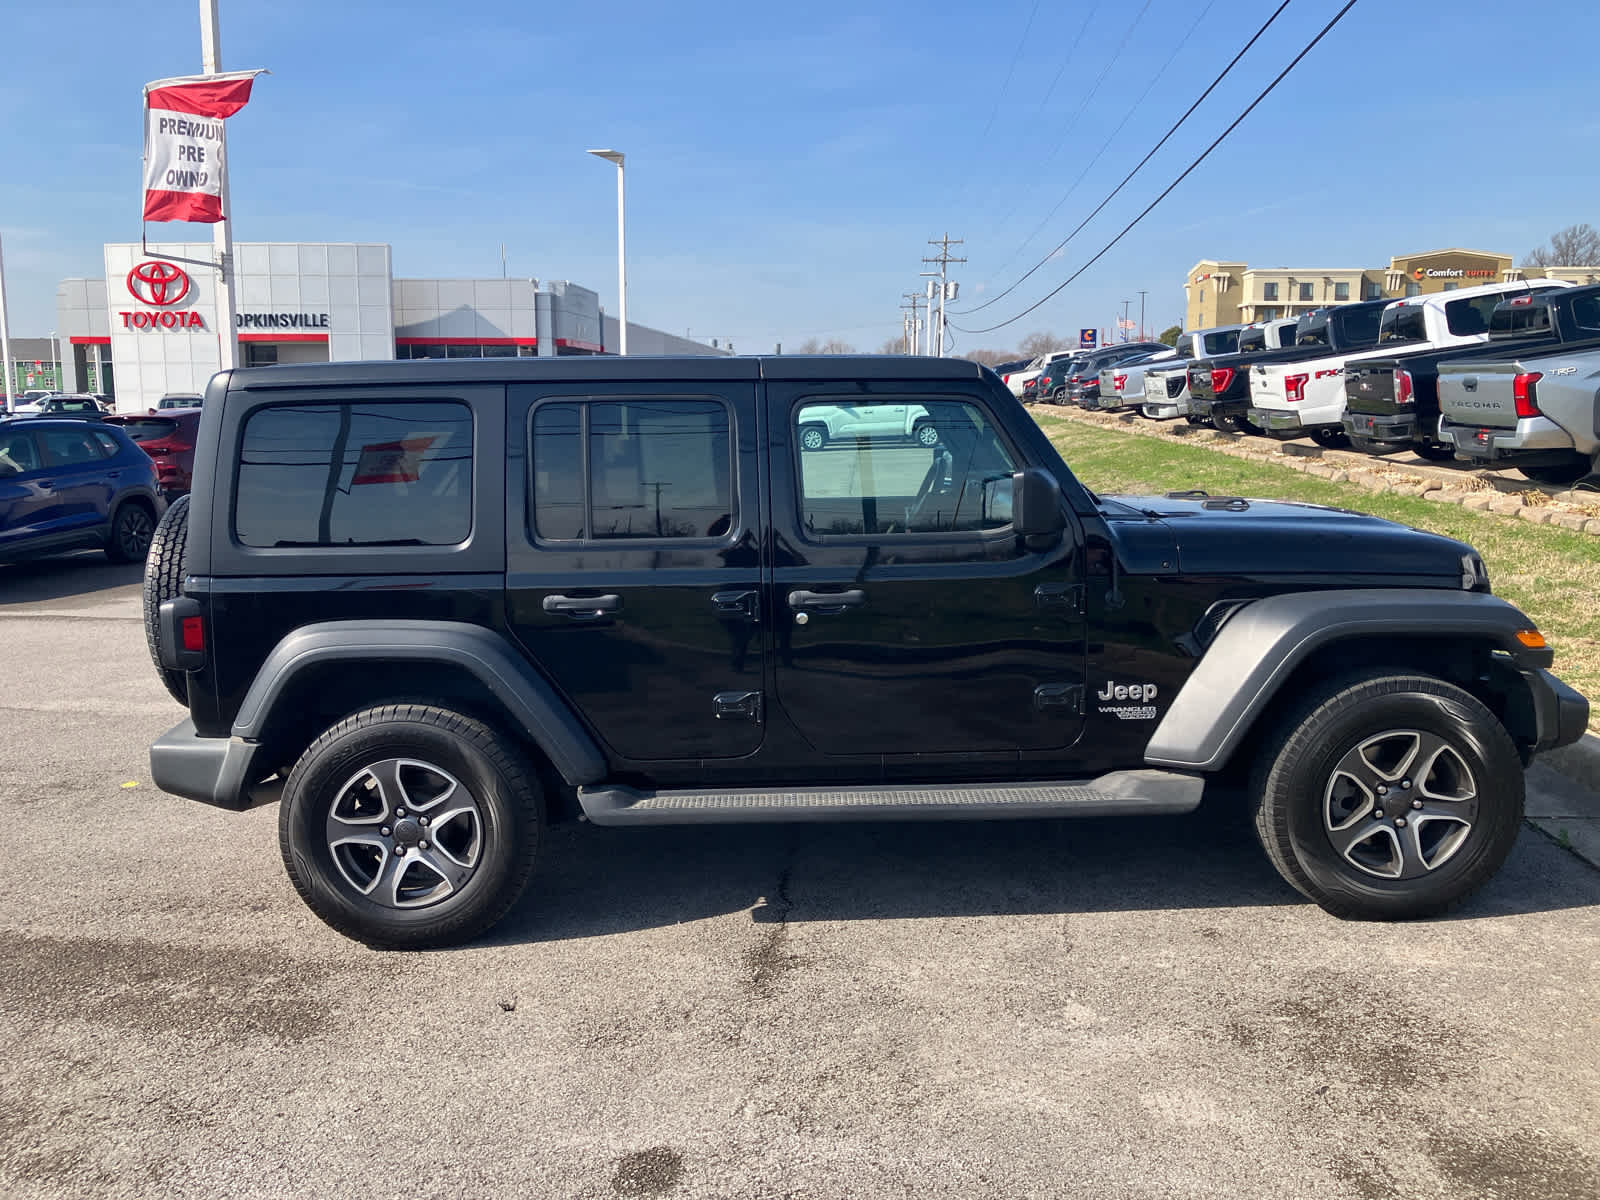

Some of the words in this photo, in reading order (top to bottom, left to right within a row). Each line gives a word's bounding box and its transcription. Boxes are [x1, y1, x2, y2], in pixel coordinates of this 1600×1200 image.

[178, 144, 205, 163] PRE
[1426, 268, 1463, 277] Comfort
[119, 311, 204, 329] TOYOTA
[1447, 400, 1501, 409] TACOMA
[1097, 680, 1158, 703] Jeep
